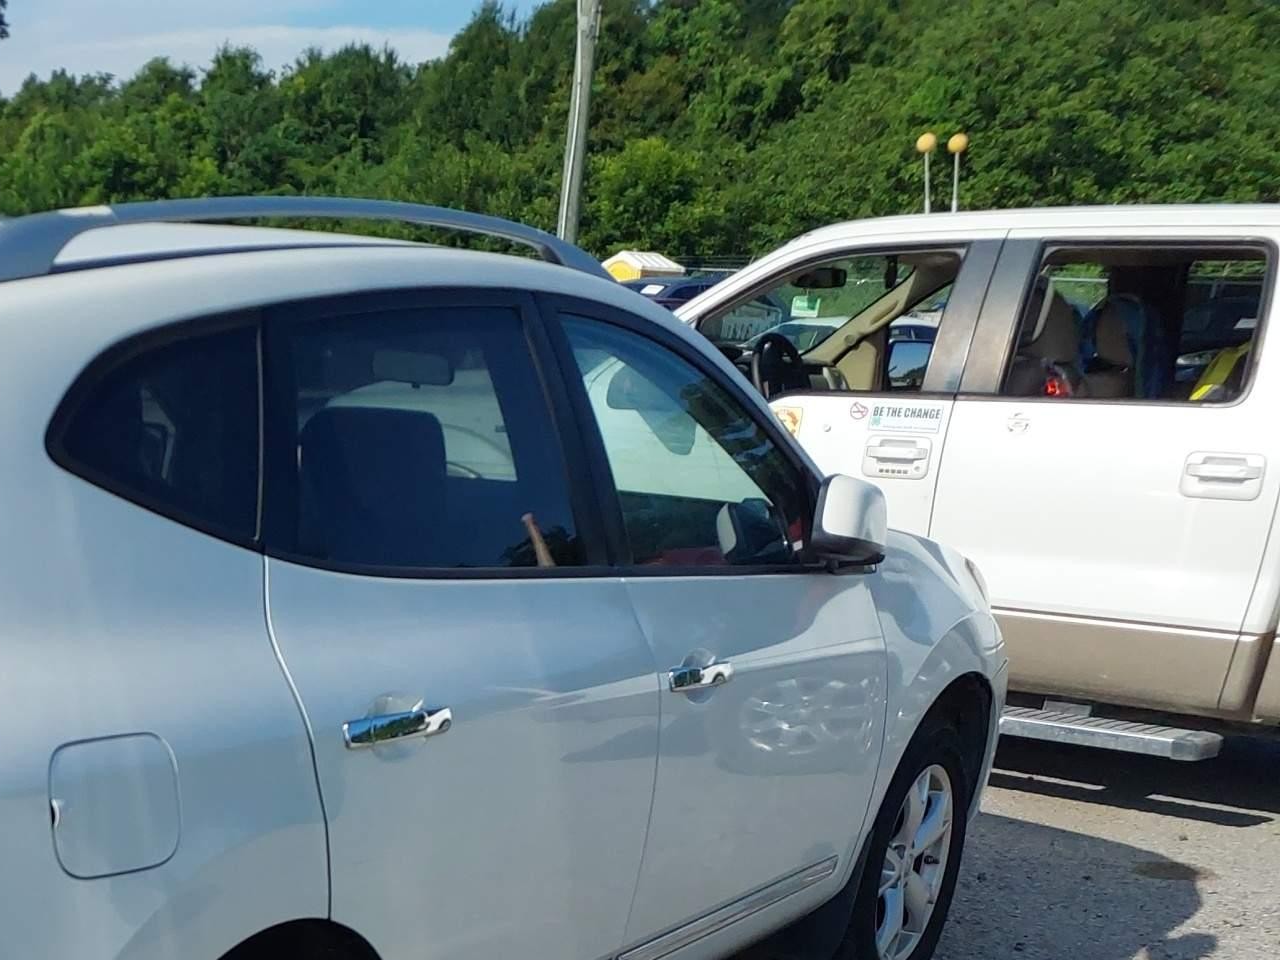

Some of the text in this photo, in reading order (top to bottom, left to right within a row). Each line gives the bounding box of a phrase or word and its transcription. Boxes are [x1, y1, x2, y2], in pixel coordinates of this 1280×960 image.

[873, 406, 941, 419] BE THE CHANGE
